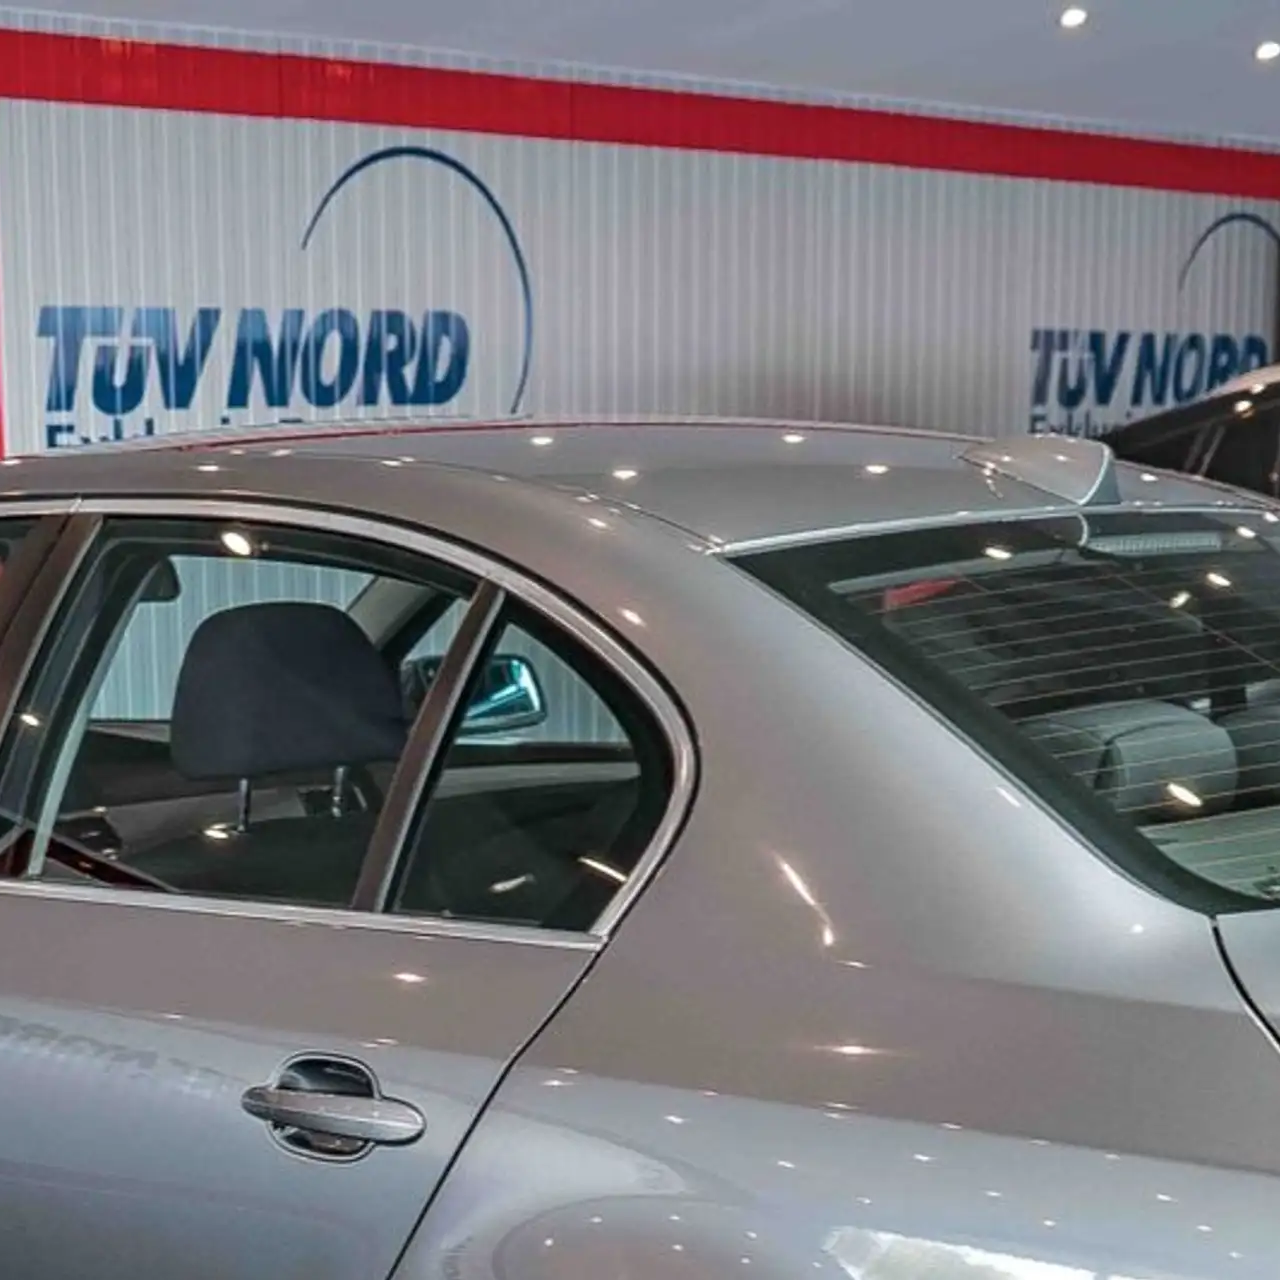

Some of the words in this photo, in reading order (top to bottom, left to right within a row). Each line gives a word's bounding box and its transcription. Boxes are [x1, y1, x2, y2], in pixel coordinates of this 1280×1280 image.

[37, 306, 220, 415] TÜV
[225, 308, 470, 408] NORD
[1029, 328, 1131, 408] TÜV
